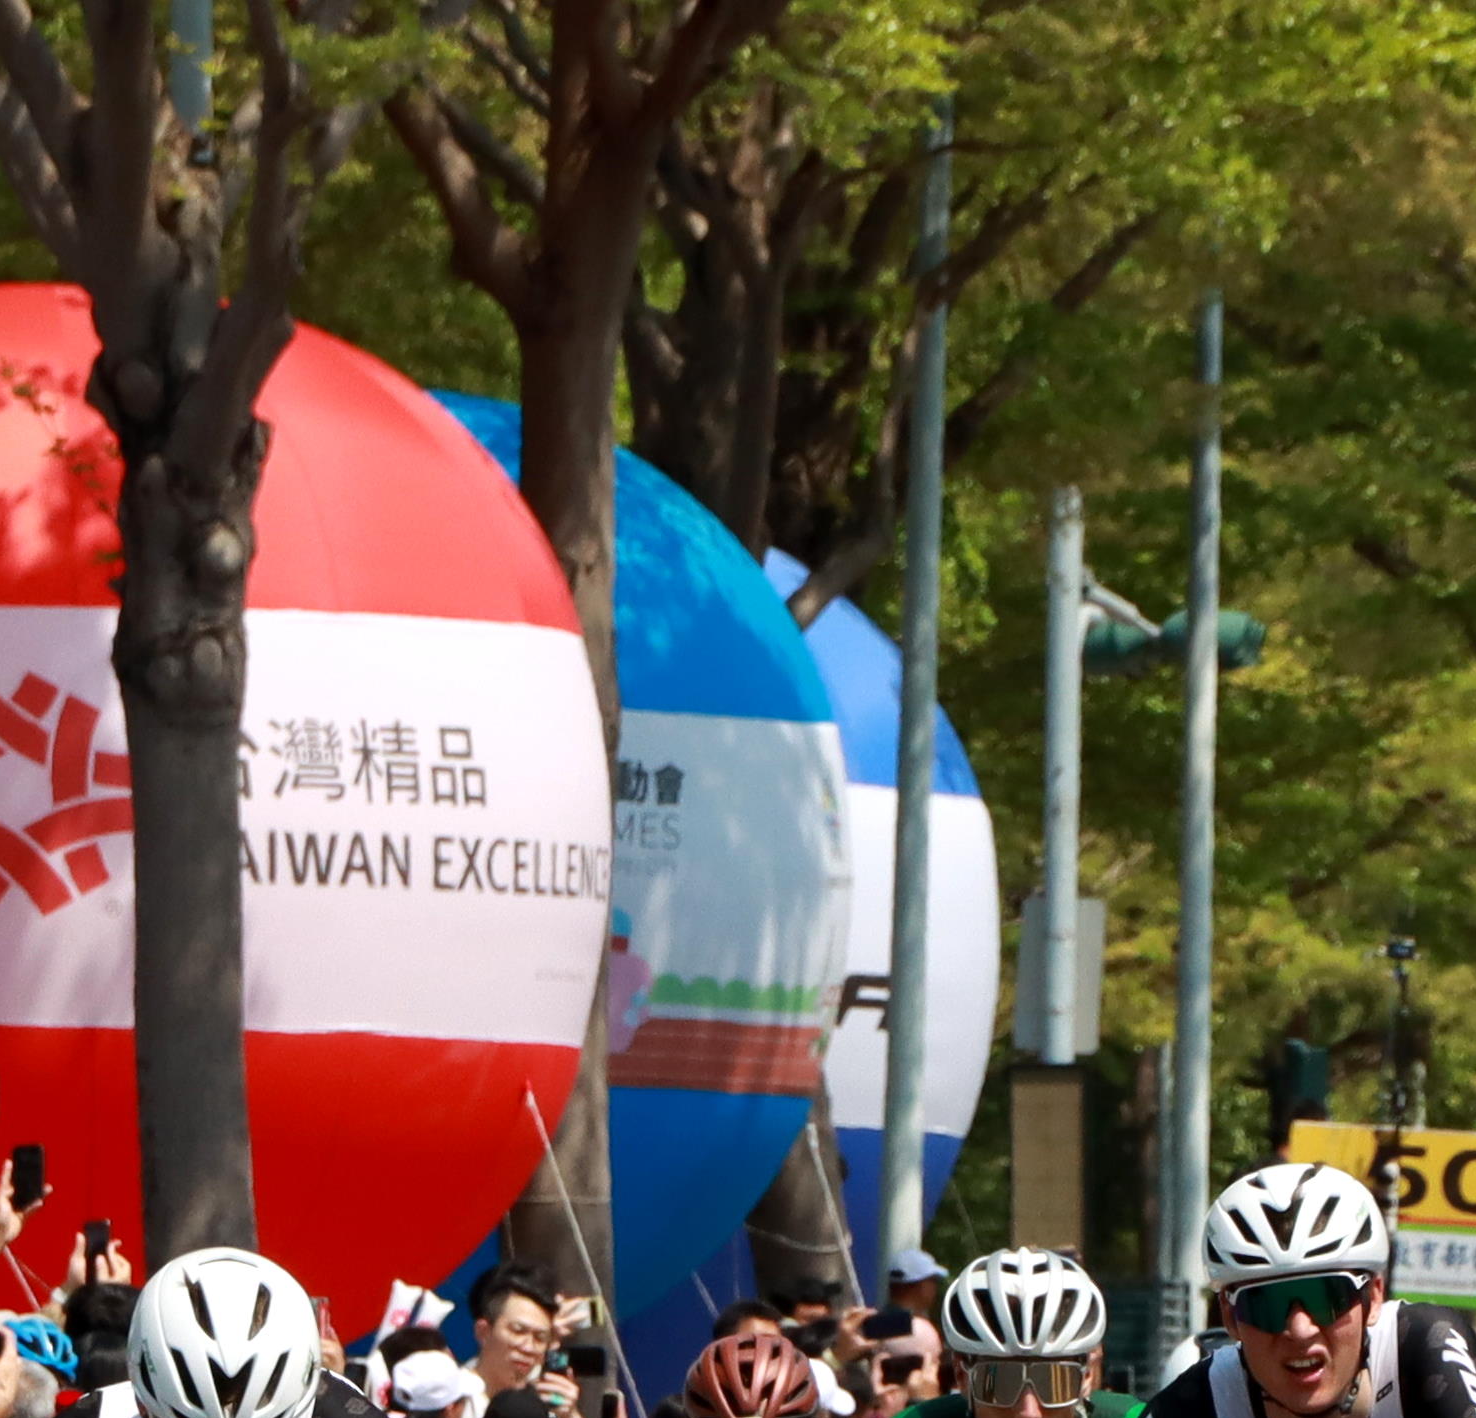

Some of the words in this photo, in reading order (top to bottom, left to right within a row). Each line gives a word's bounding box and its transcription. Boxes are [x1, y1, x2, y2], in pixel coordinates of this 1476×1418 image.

[237, 717, 488, 809] 灣精品
[238, 829, 412, 890] AIWAN
